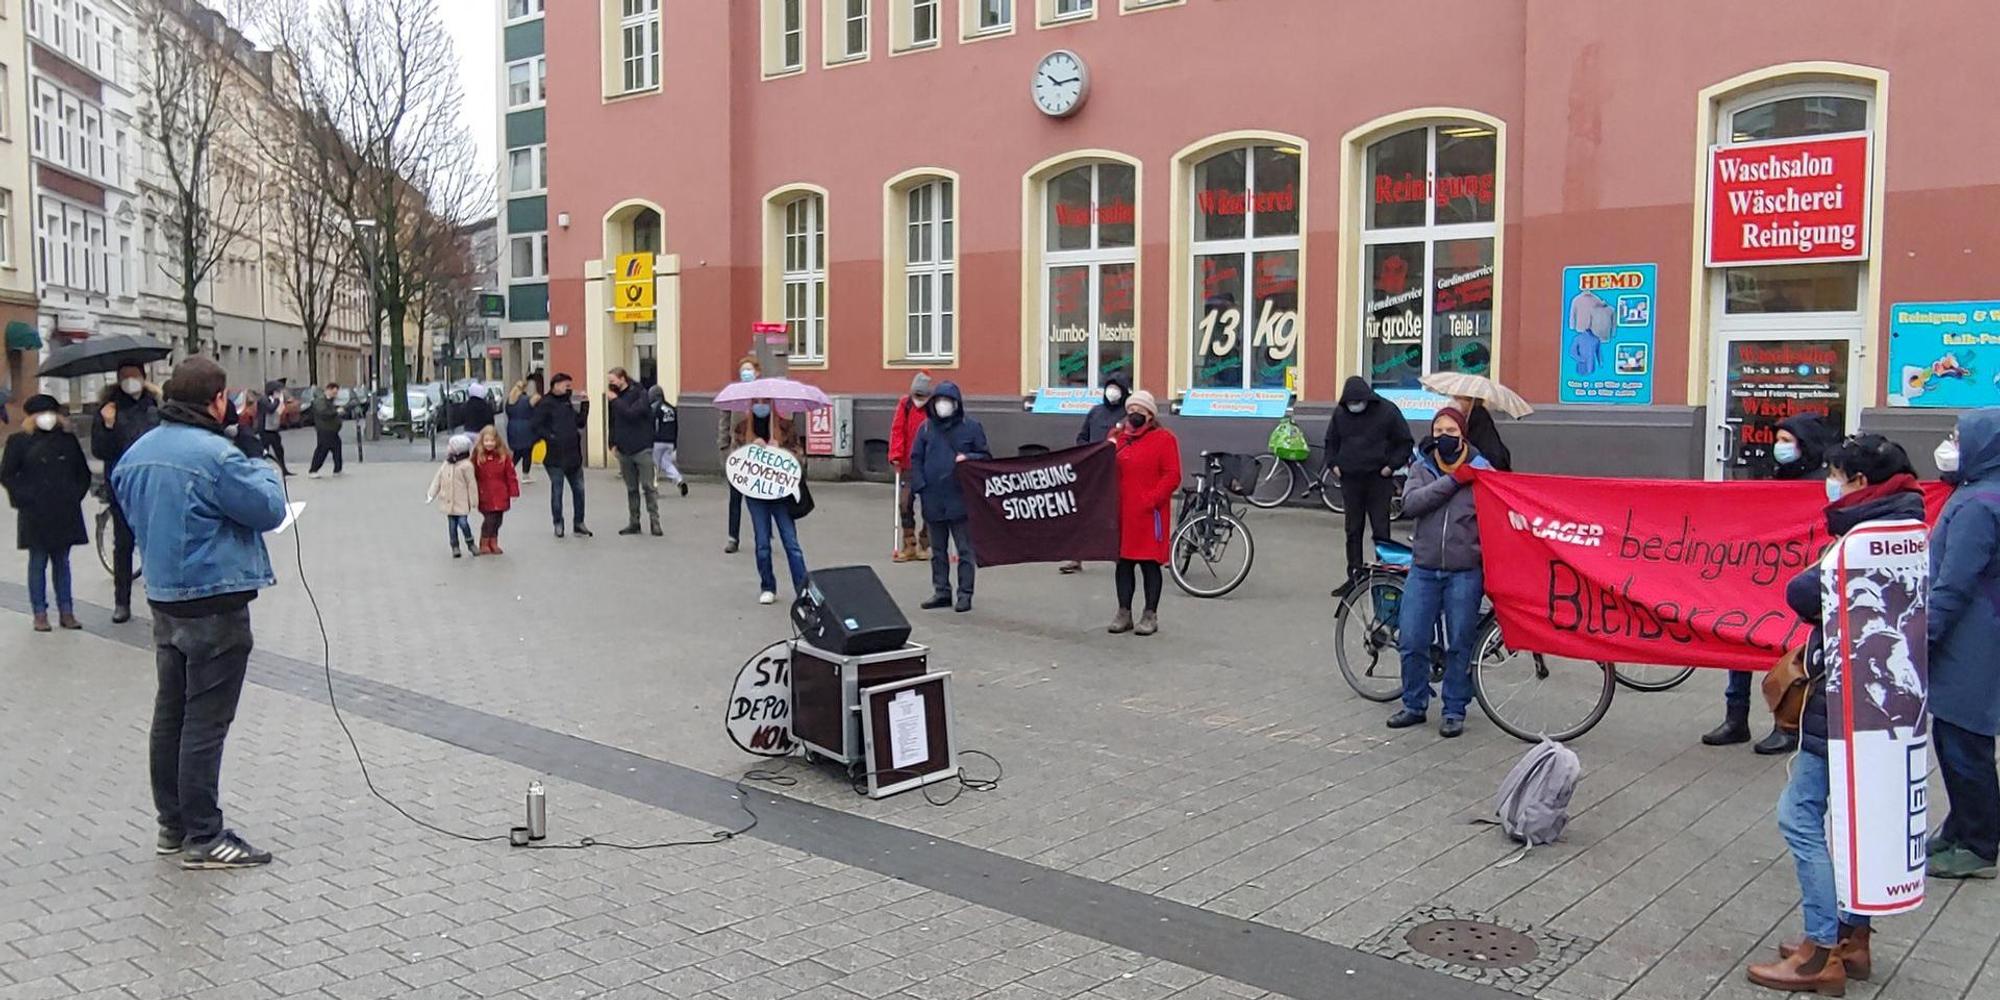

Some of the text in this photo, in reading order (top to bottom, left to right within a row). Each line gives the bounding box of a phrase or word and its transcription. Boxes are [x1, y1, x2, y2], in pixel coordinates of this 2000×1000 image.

[1719, 152, 1833, 183] Waschsalon
[1375, 172, 1494, 207] Reinigung
[1728, 183, 1843, 216] Wäscherei
[1742, 221, 1856, 252] Reinigung
[1580, 273, 1643, 289] HEMD
[1050, 322, 1136, 342] Jumbo- Maschine
[1199, 299, 1299, 360] 13 kg
[1366, 309, 1422, 344] für große
[1449, 314, 1472, 337] Teile
[740, 460, 799, 488] MOVEMENT
[747, 446, 797, 475] FREEDOM
[733, 473, 748, 486] FOR
[750, 479, 773, 495] ALL
[985, 463, 1077, 498] ABSCHIEBUNG
[1002, 490, 1078, 520] STOPPEN!
[1531, 517, 1605, 547] LAGER
[1870, 539, 1926, 555] Bleibe
[731, 695, 788, 721] DEPO
